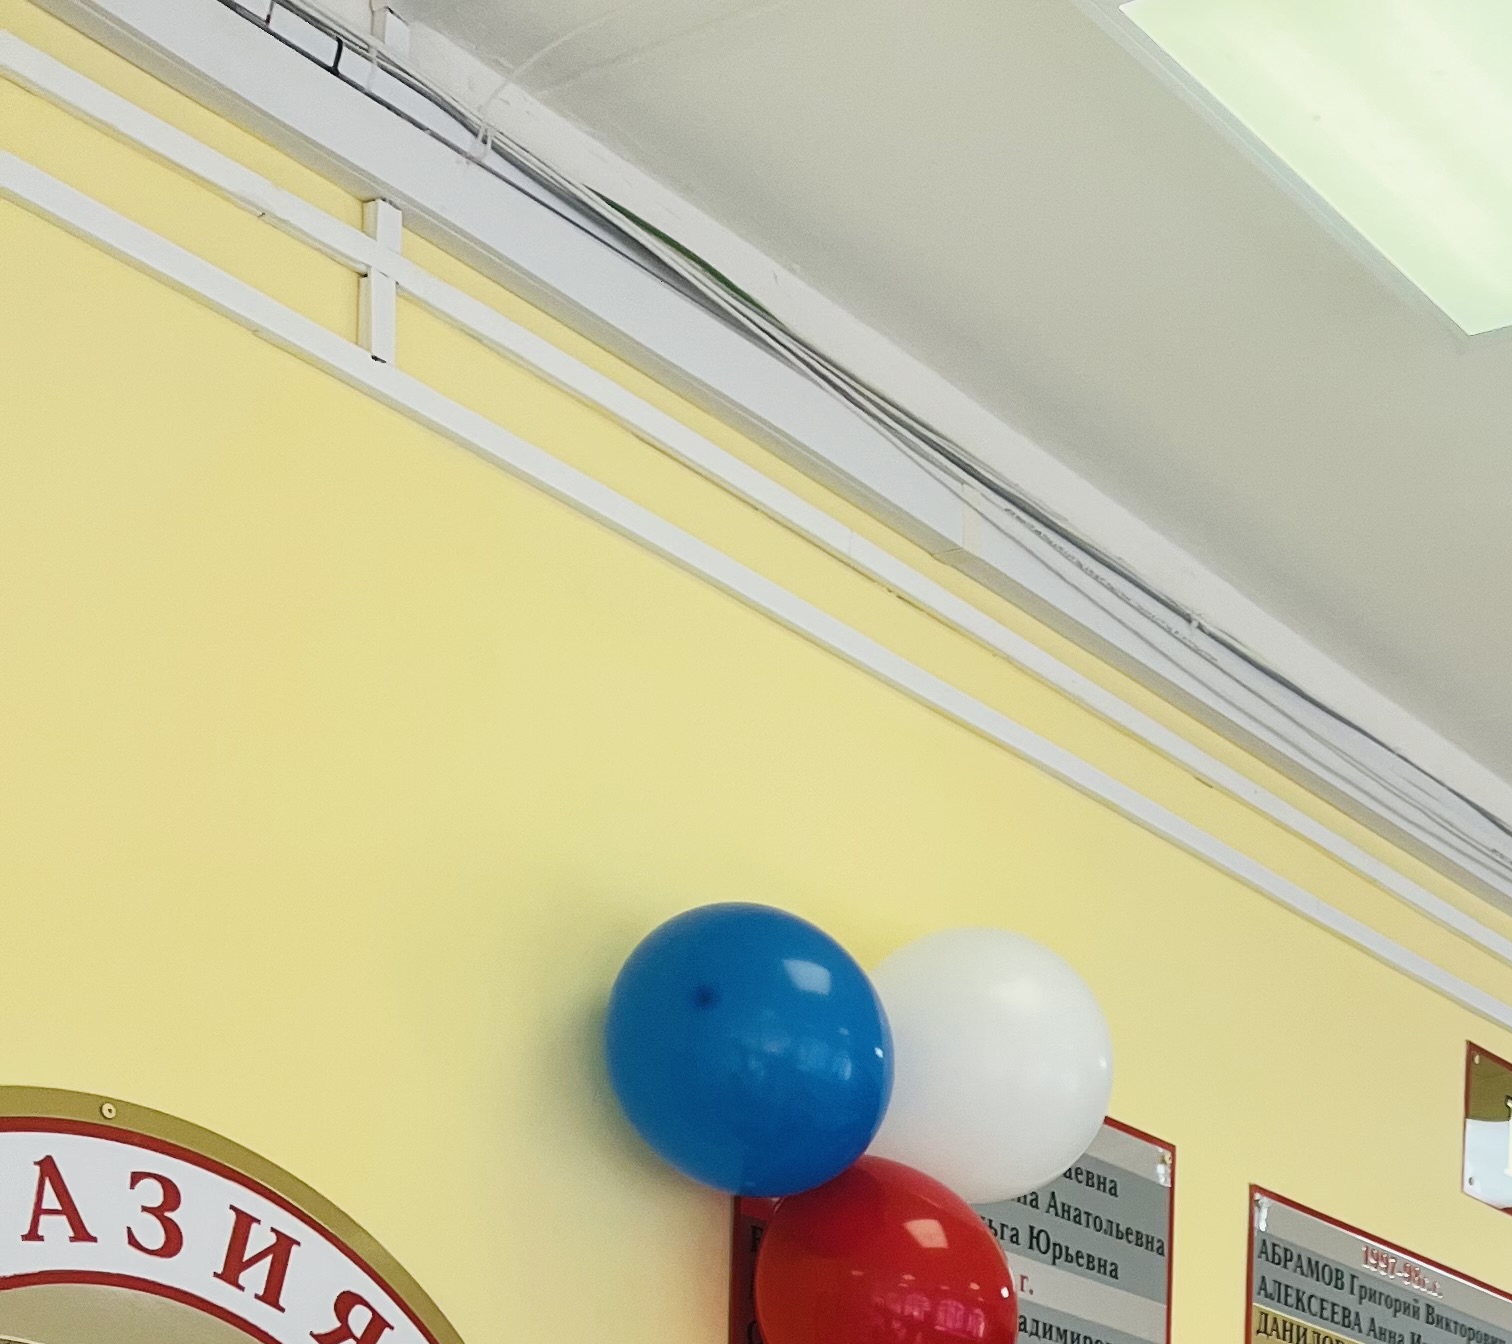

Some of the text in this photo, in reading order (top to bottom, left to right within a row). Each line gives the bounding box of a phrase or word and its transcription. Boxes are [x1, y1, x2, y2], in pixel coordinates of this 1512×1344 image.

[982, 1215, 1120, 1280] ьга Юрьевна
[1044, 1188, 1166, 1258] Анатольевна
[1255, 1272, 1363, 1333] АЛЕКСЕЕВА
[1256, 1236, 1345, 1292] АБРАМОВ
[1348, 1272, 1421, 1321] Григорий
